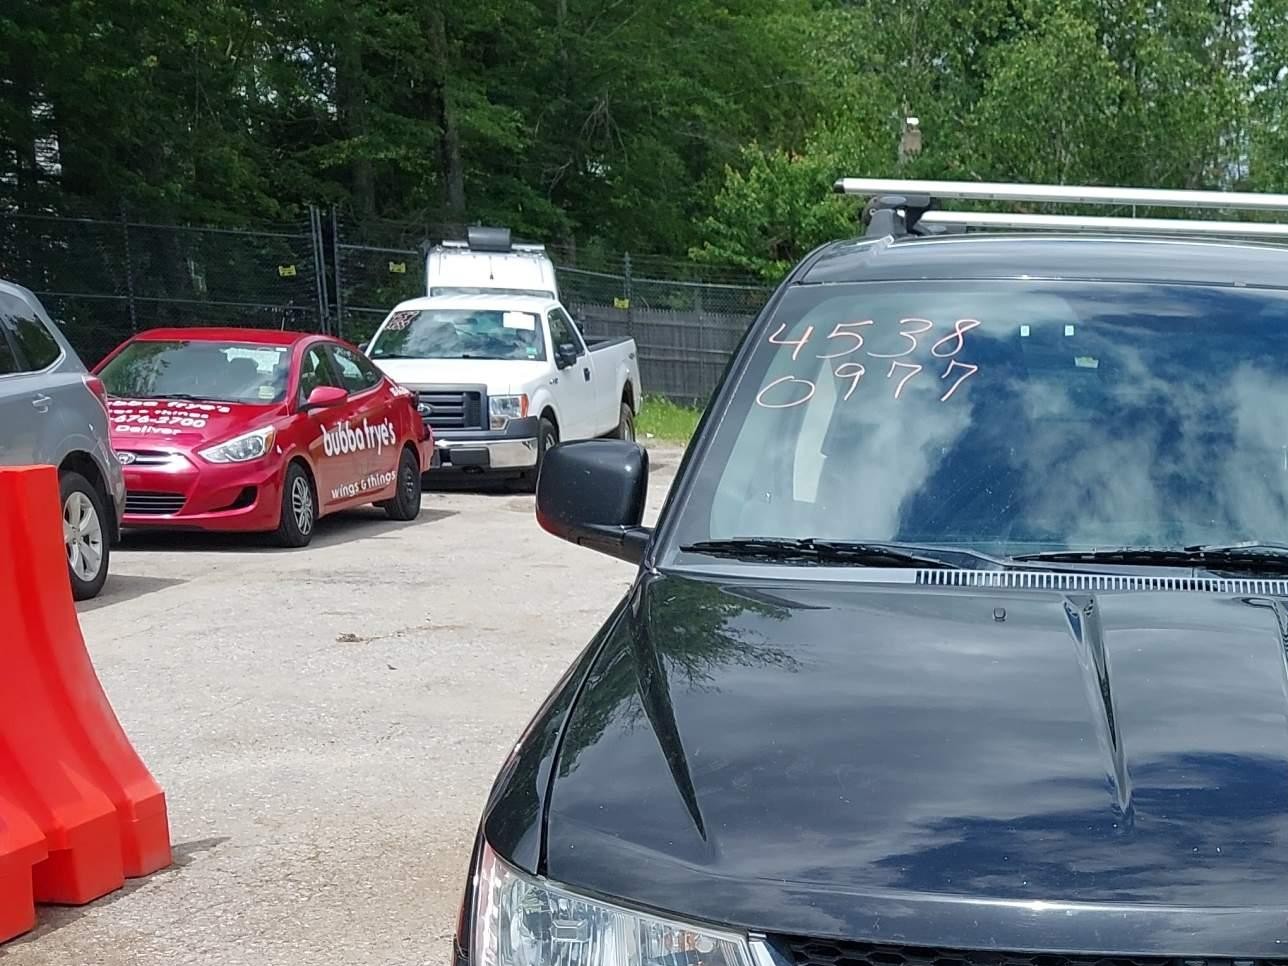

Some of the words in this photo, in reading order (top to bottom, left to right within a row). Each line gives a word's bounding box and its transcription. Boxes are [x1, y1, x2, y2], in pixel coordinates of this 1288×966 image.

[768, 318, 981, 361] 4538
[756, 359, 978, 408] 0977
[115, 424, 182, 436] Deliver
[320, 420, 365, 457] bubba
[363, 416, 396, 456] frye's
[331, 481, 359, 499] wings
[367, 470, 396, 488] things
